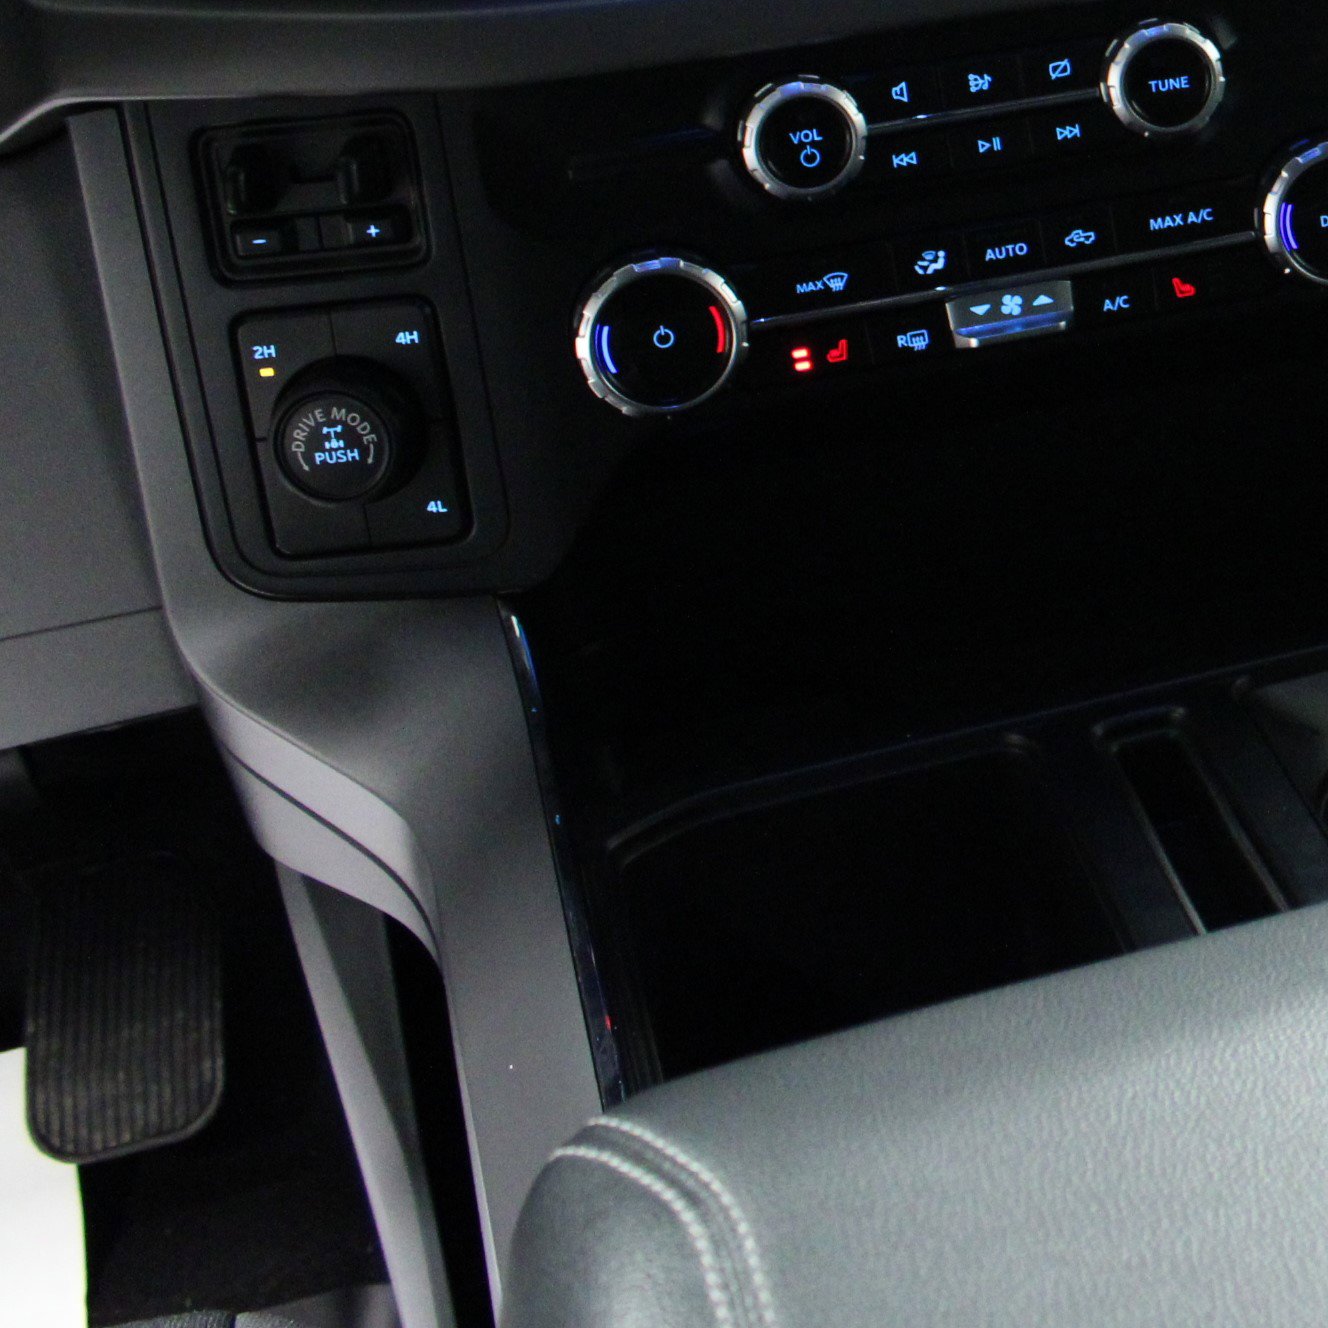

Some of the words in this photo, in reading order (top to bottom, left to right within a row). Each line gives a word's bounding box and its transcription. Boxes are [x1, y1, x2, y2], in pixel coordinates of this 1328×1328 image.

[1148, 75, 1189, 93] TUNE
[789, 127, 823, 144] VOL
[1149, 212, 1179, 231] MAX
[1180, 207, 1214, 227] A/C
[984, 241, 1028, 261] AUTO
[795, 279, 824, 294] MAX
[1103, 294, 1130, 312] A/C
[395, 330, 420, 346] 4H
[896, 332, 908, 348] R
[252, 344, 276, 360] 2H
[292, 408, 326, 452] DRIVE
[330, 406, 377, 445] MODE
[314, 448, 360, 465] PUSH
[426, 499, 448, 514] 4L
